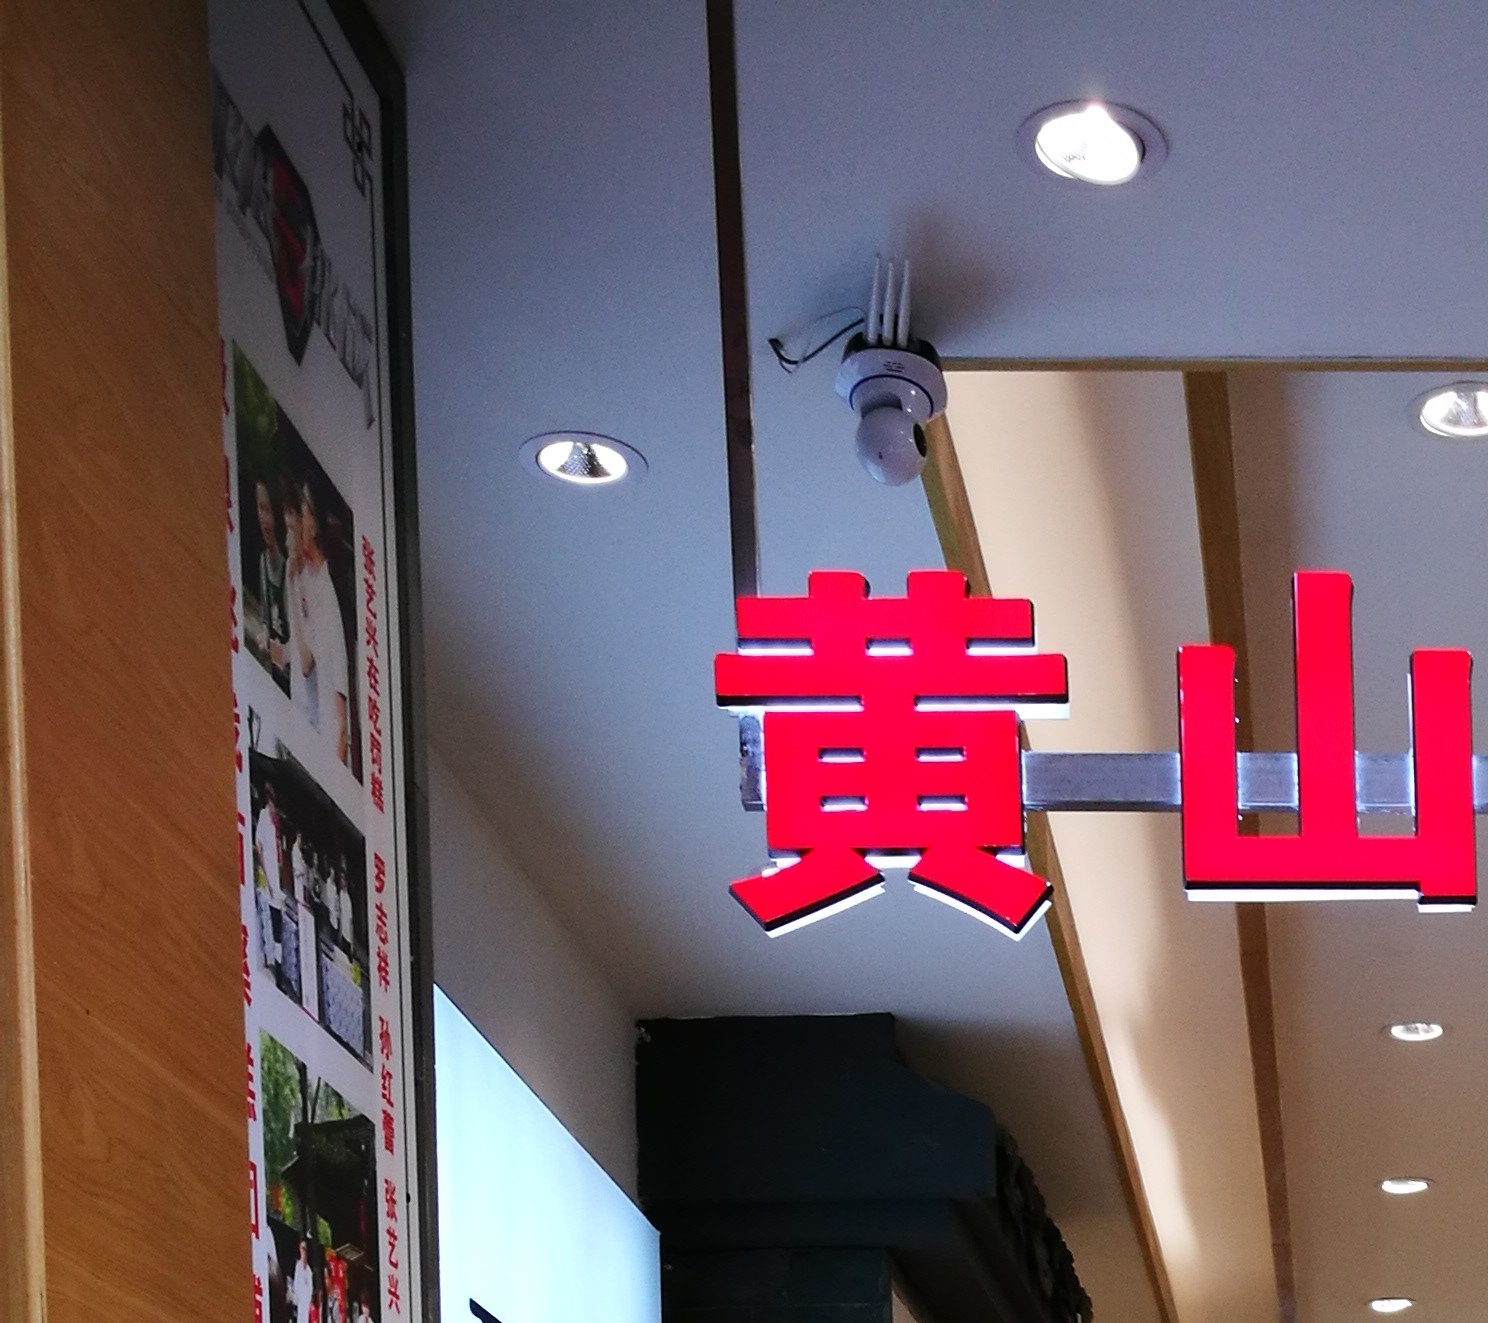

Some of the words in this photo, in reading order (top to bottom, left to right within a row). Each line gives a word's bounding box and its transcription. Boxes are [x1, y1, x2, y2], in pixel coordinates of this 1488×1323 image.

[373, 851, 390, 990] 罗志祥
[378, 1015, 396, 1155] 孙红雷
[384, 1176, 401, 1312] 张艺兴
